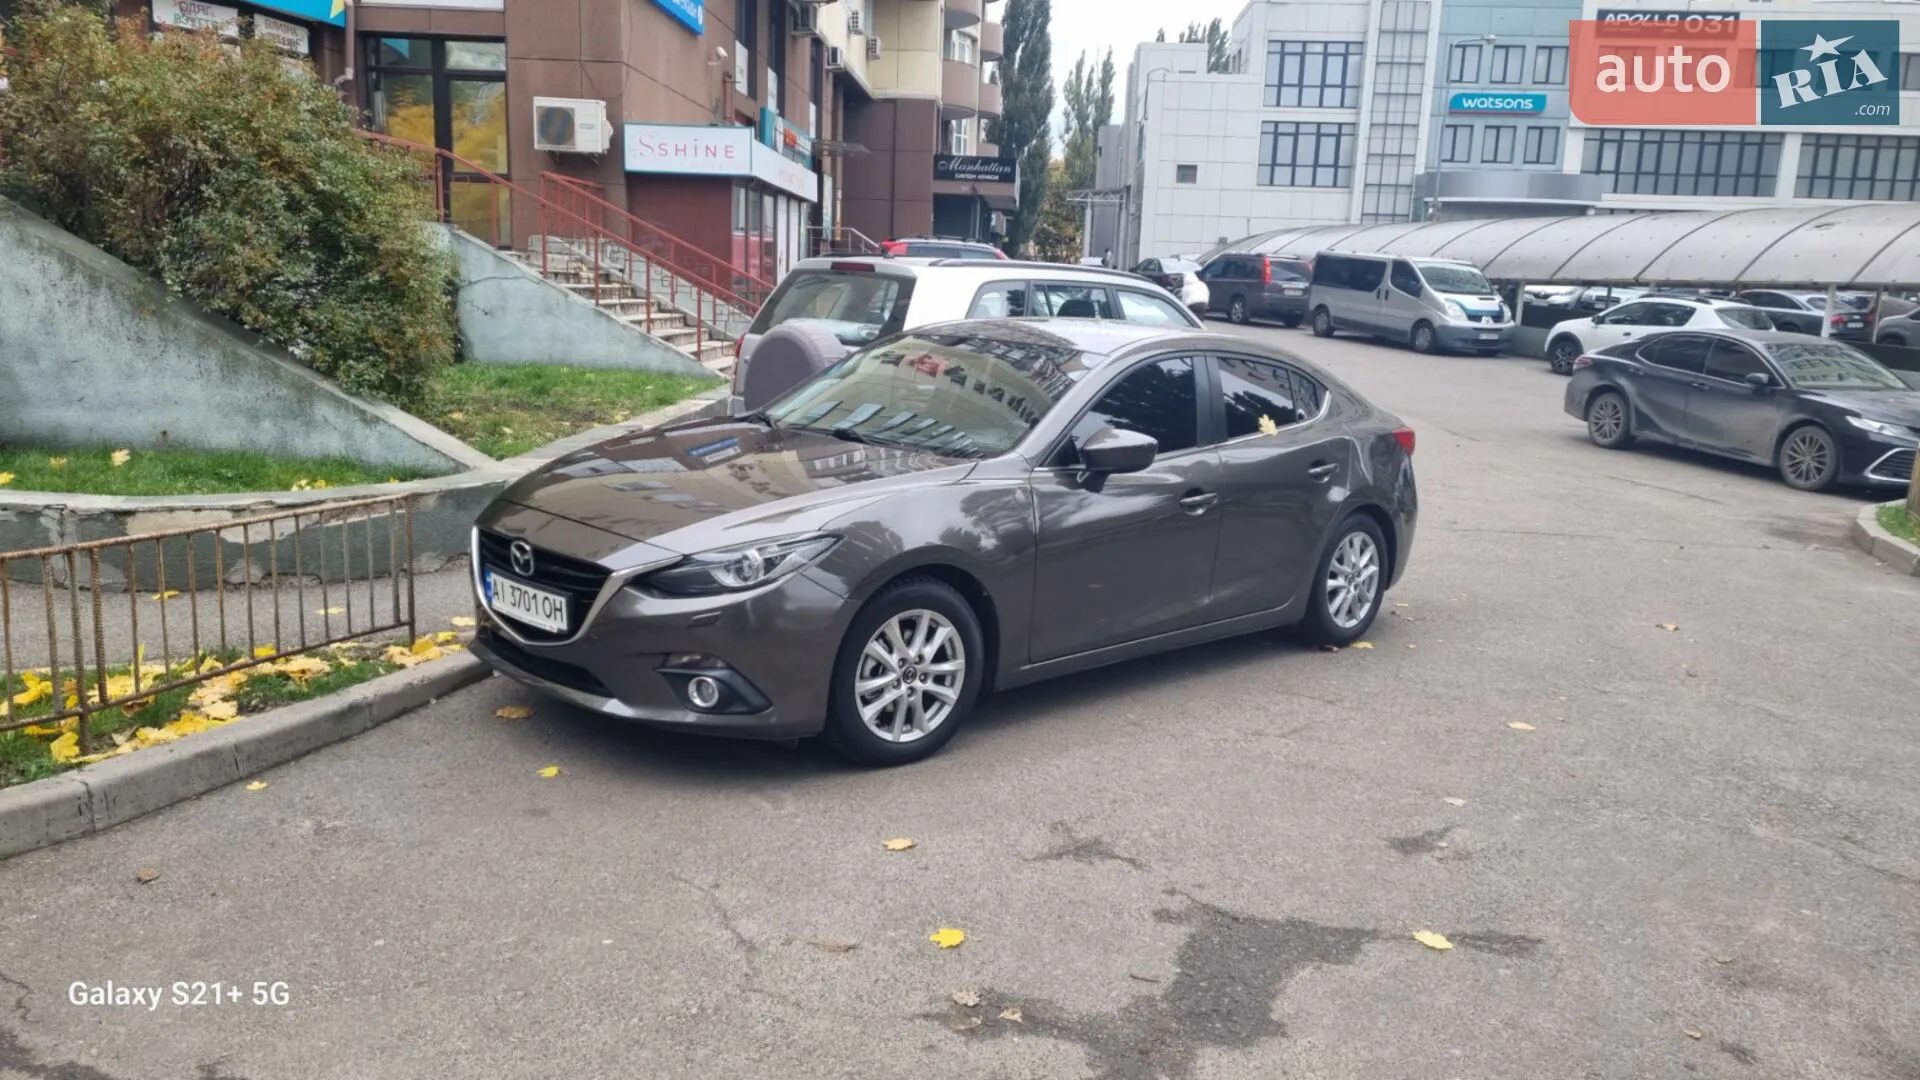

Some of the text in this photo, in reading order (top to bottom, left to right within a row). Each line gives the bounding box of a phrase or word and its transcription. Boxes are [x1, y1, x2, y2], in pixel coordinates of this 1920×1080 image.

[1603, 13, 1736, 33] APOLLO 031
[1462, 97, 1535, 110] watsons
[948, 156, 1012, 173] Manhattan
[509, 584, 539, 616] 3701
[542, 596, 564, 623] OH
